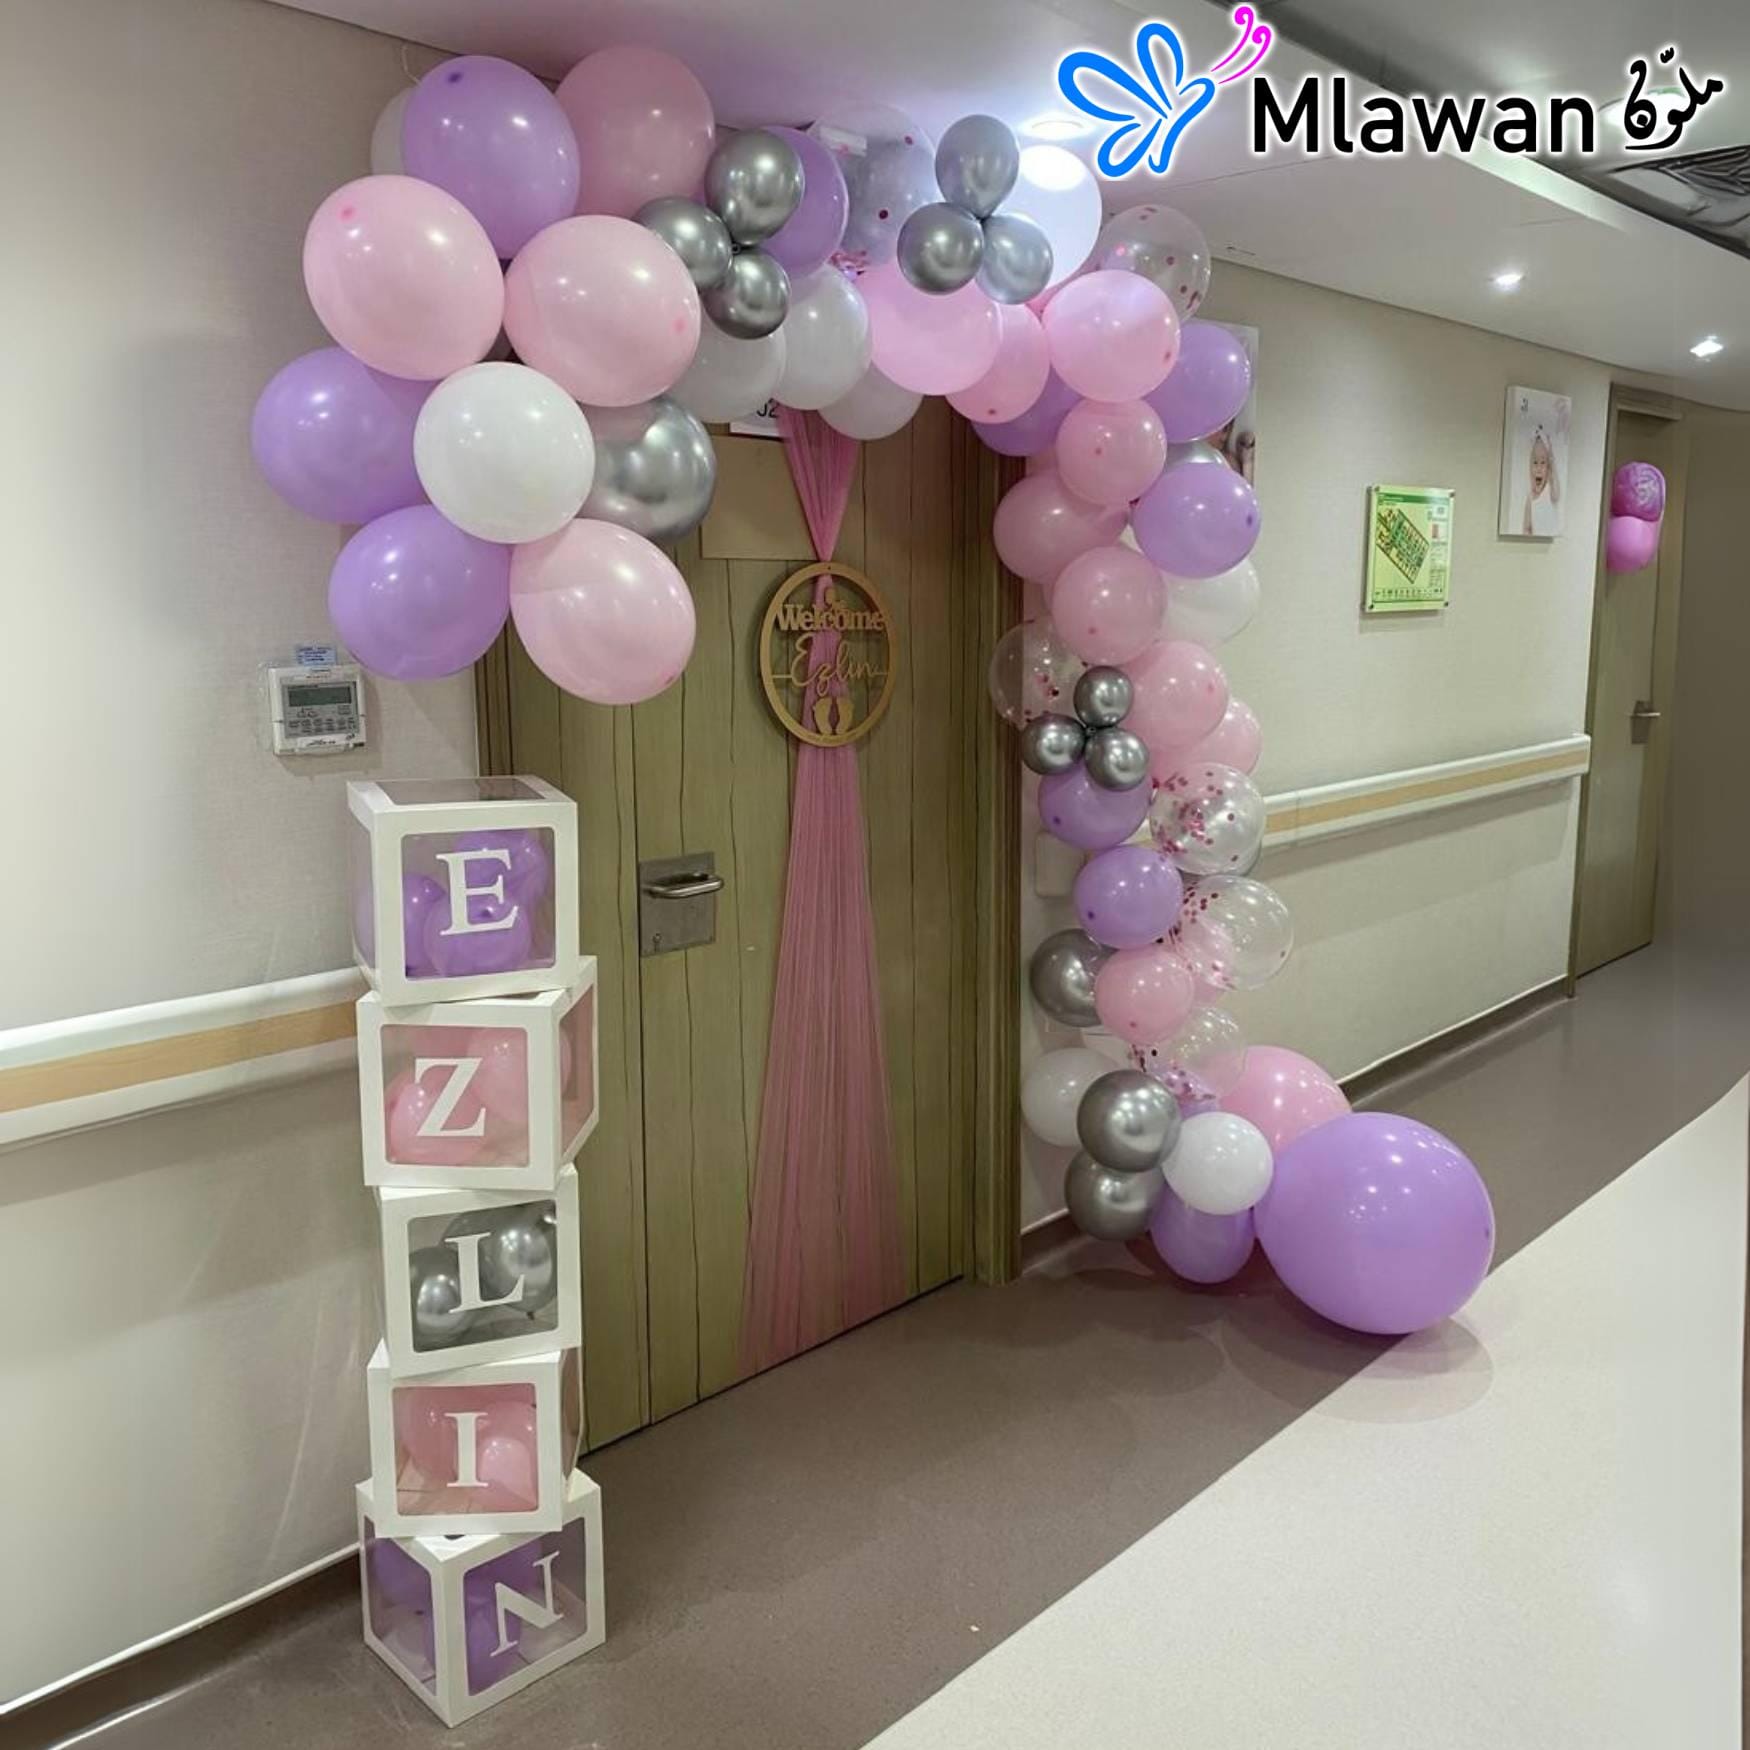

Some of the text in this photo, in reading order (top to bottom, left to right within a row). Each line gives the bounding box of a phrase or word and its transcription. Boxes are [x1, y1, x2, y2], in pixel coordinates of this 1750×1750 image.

[776, 604, 886, 631] Welcome
[791, 633, 879, 697] Ezlin
[435, 848, 519, 937] E
[414, 1057, 487, 1138] Z
[444, 1231, 526, 1314] L
[445, 1412, 489, 1487] I
[490, 1551, 564, 1657] N
